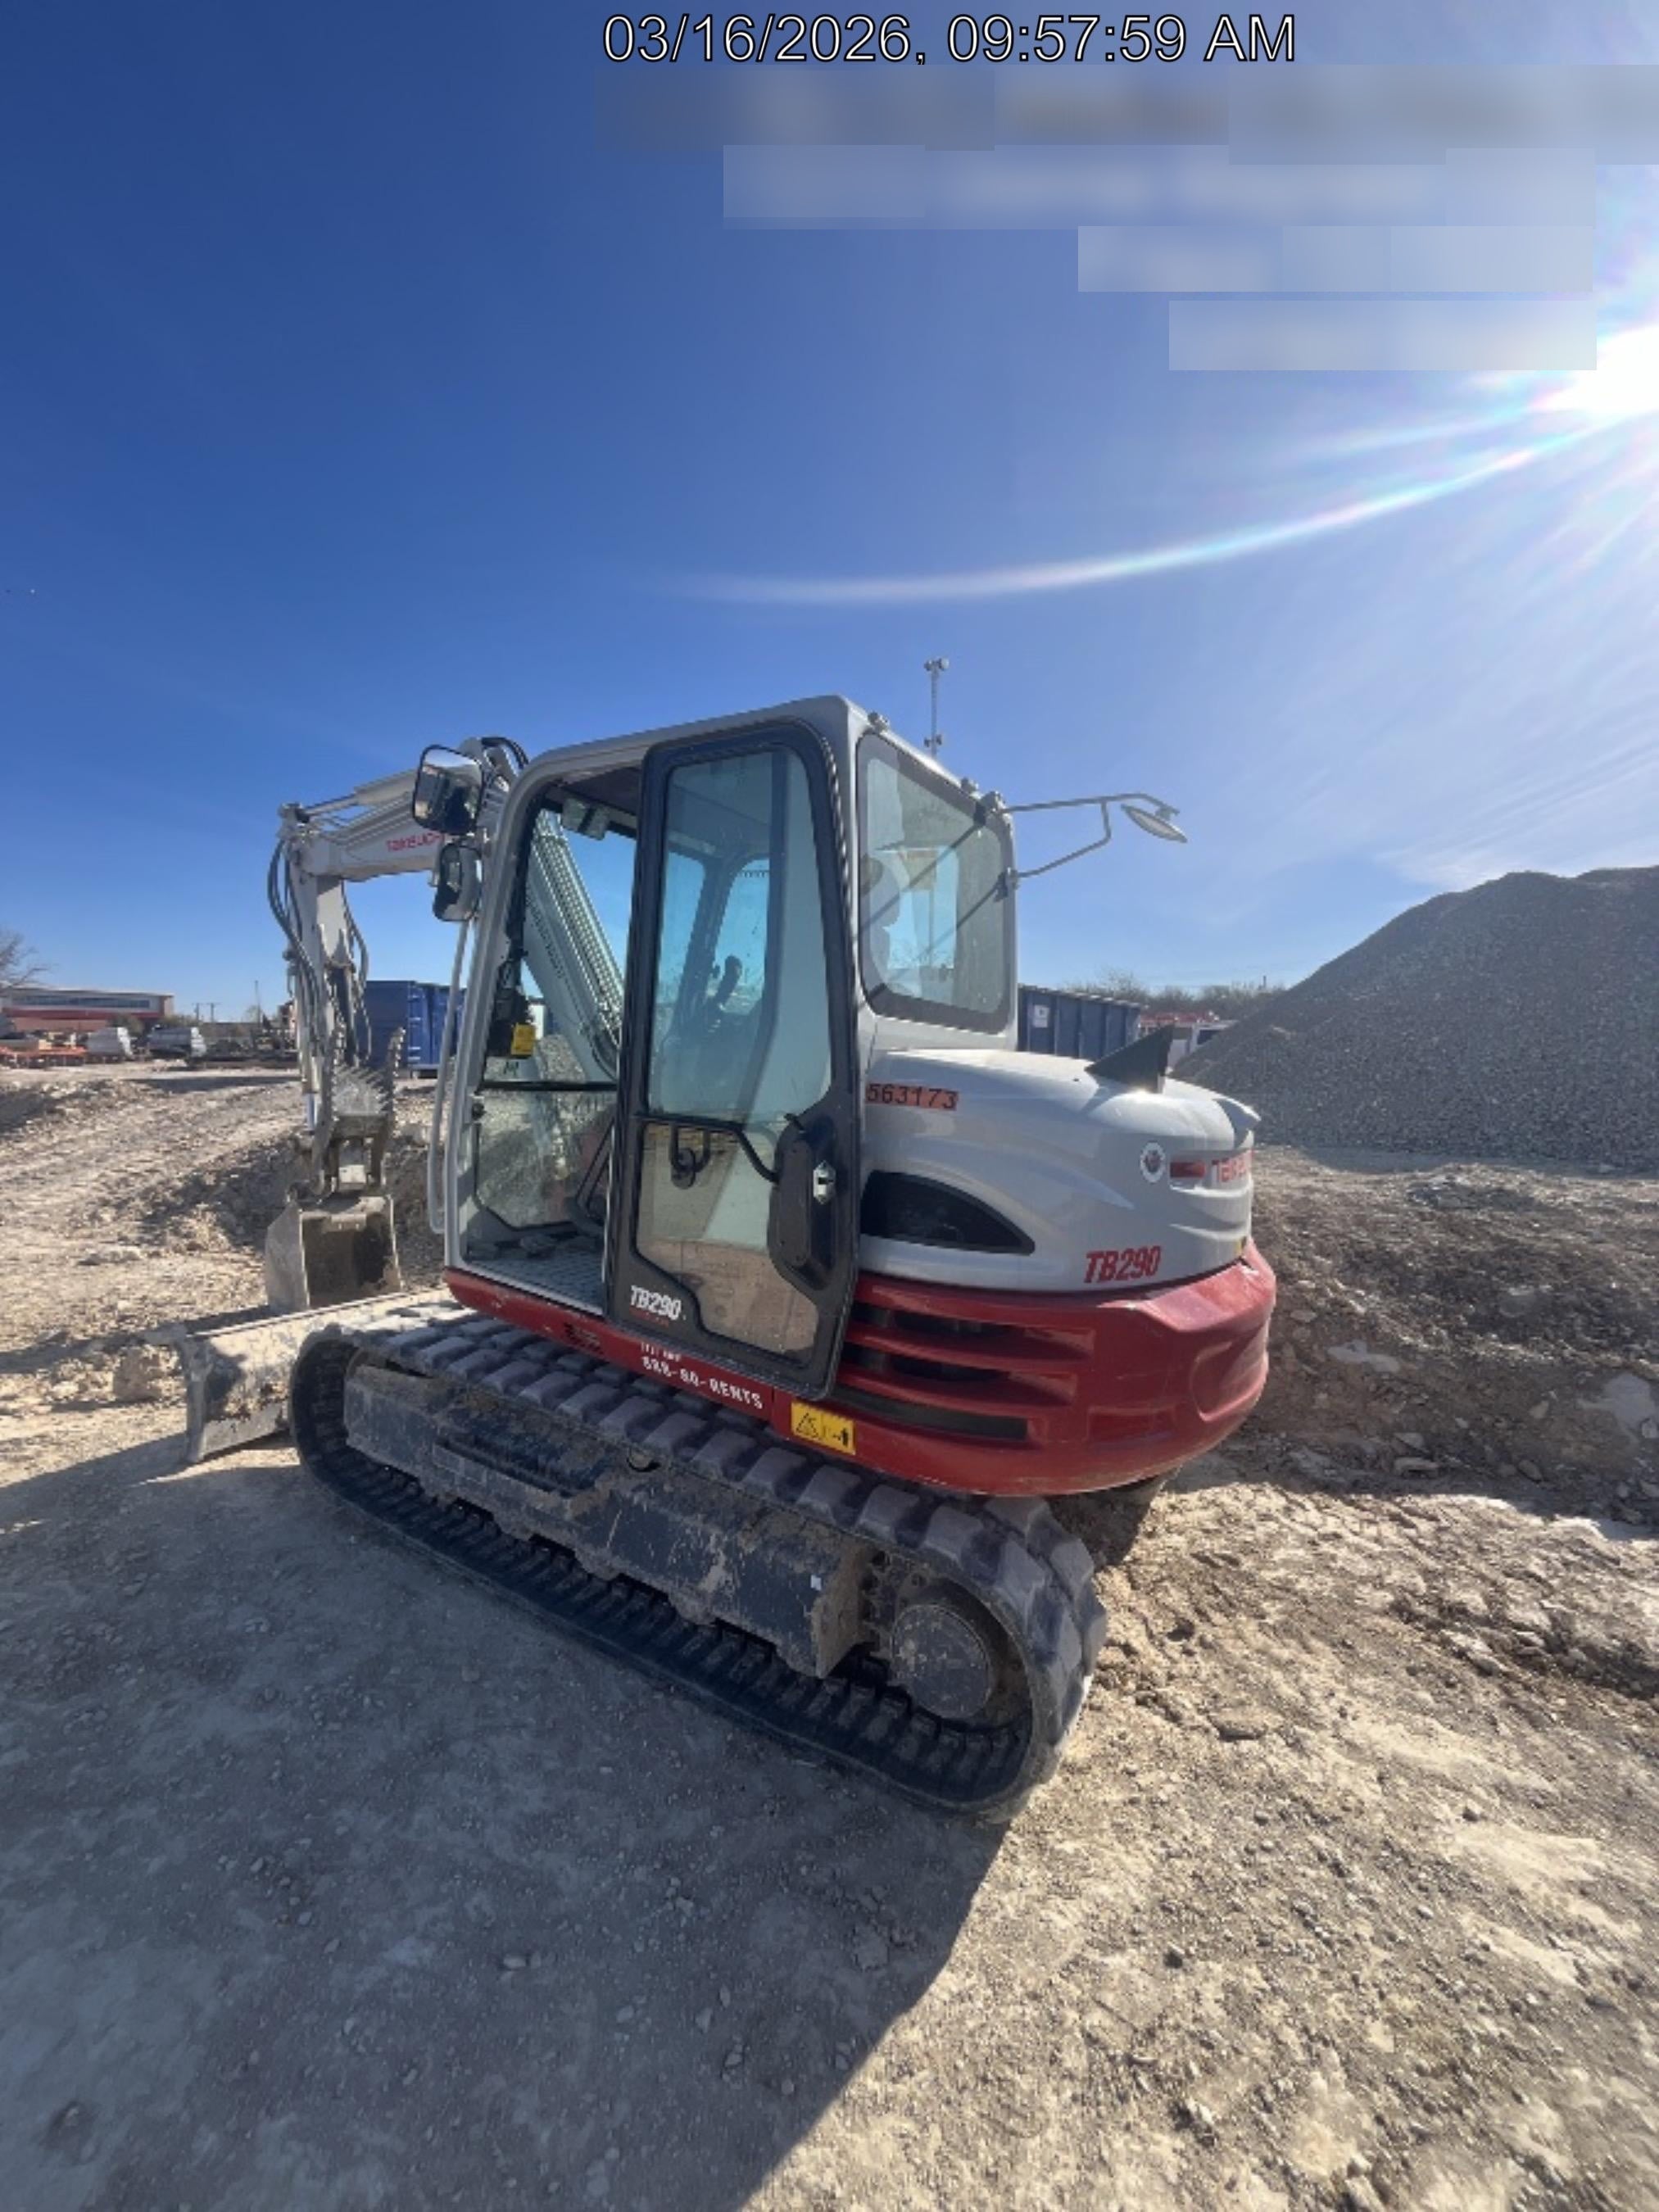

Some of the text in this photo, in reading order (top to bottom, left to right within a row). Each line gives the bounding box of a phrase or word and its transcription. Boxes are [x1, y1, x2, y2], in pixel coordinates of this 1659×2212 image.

[867, 1083, 959, 1109] 563173
[1084, 1246, 1161, 1284] TB290
[630, 1284, 682, 1321] TB290
